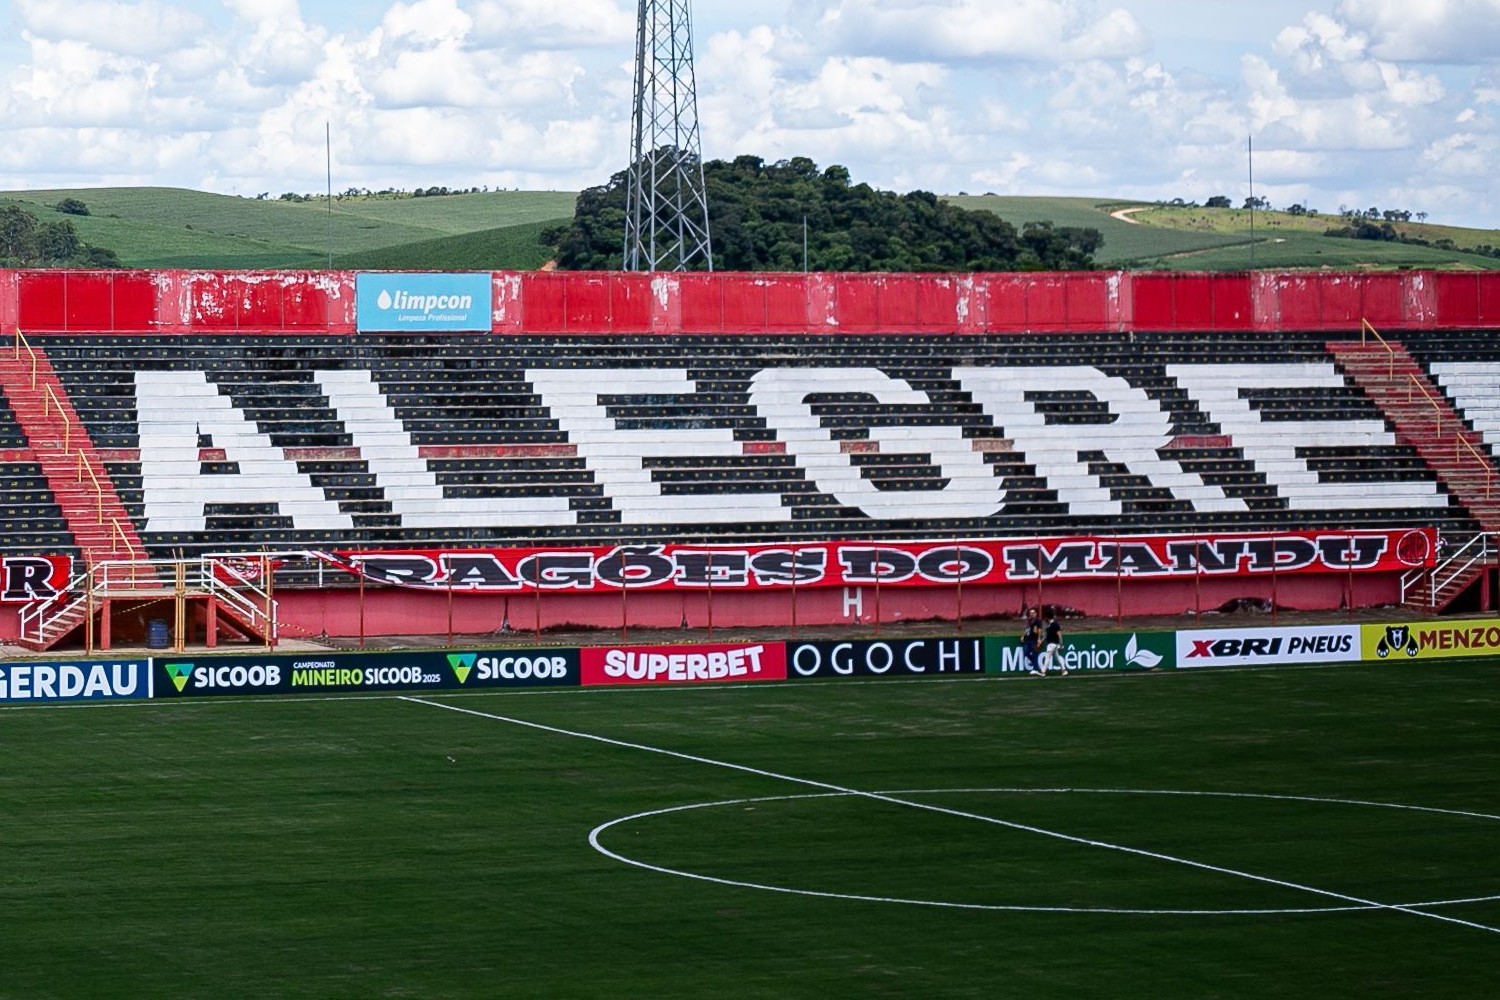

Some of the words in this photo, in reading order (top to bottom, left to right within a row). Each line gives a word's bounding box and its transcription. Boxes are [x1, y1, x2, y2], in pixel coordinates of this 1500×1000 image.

[393, 289, 472, 314] limpcon
[398, 313, 427, 323] Limpeza
[427, 313, 468, 322] Profissional
[134, 362, 1449, 530] ALEGRE
[330, 543, 827, 590] RAGÕES
[837, 545, 994, 583] DO
[1002, 533, 1390, 580] MANDU
[843, 586, 863, 617] H
[793, 639, 981, 676] OGOCHI
[1186, 637, 1283, 658] XBRI
[1287, 635, 1353, 655] PNEUS
[292, 661, 336, 669] CAMPEONATO
[477, 657, 568, 679] SICOOB
[603, 645, 765, 681] SUPERBET
[194, 665, 281, 688] SICOOB
[291, 669, 363, 687] MINEIRO
[364, 667, 422, 685] SICOOB
[422, 674, 441, 683] 2025
